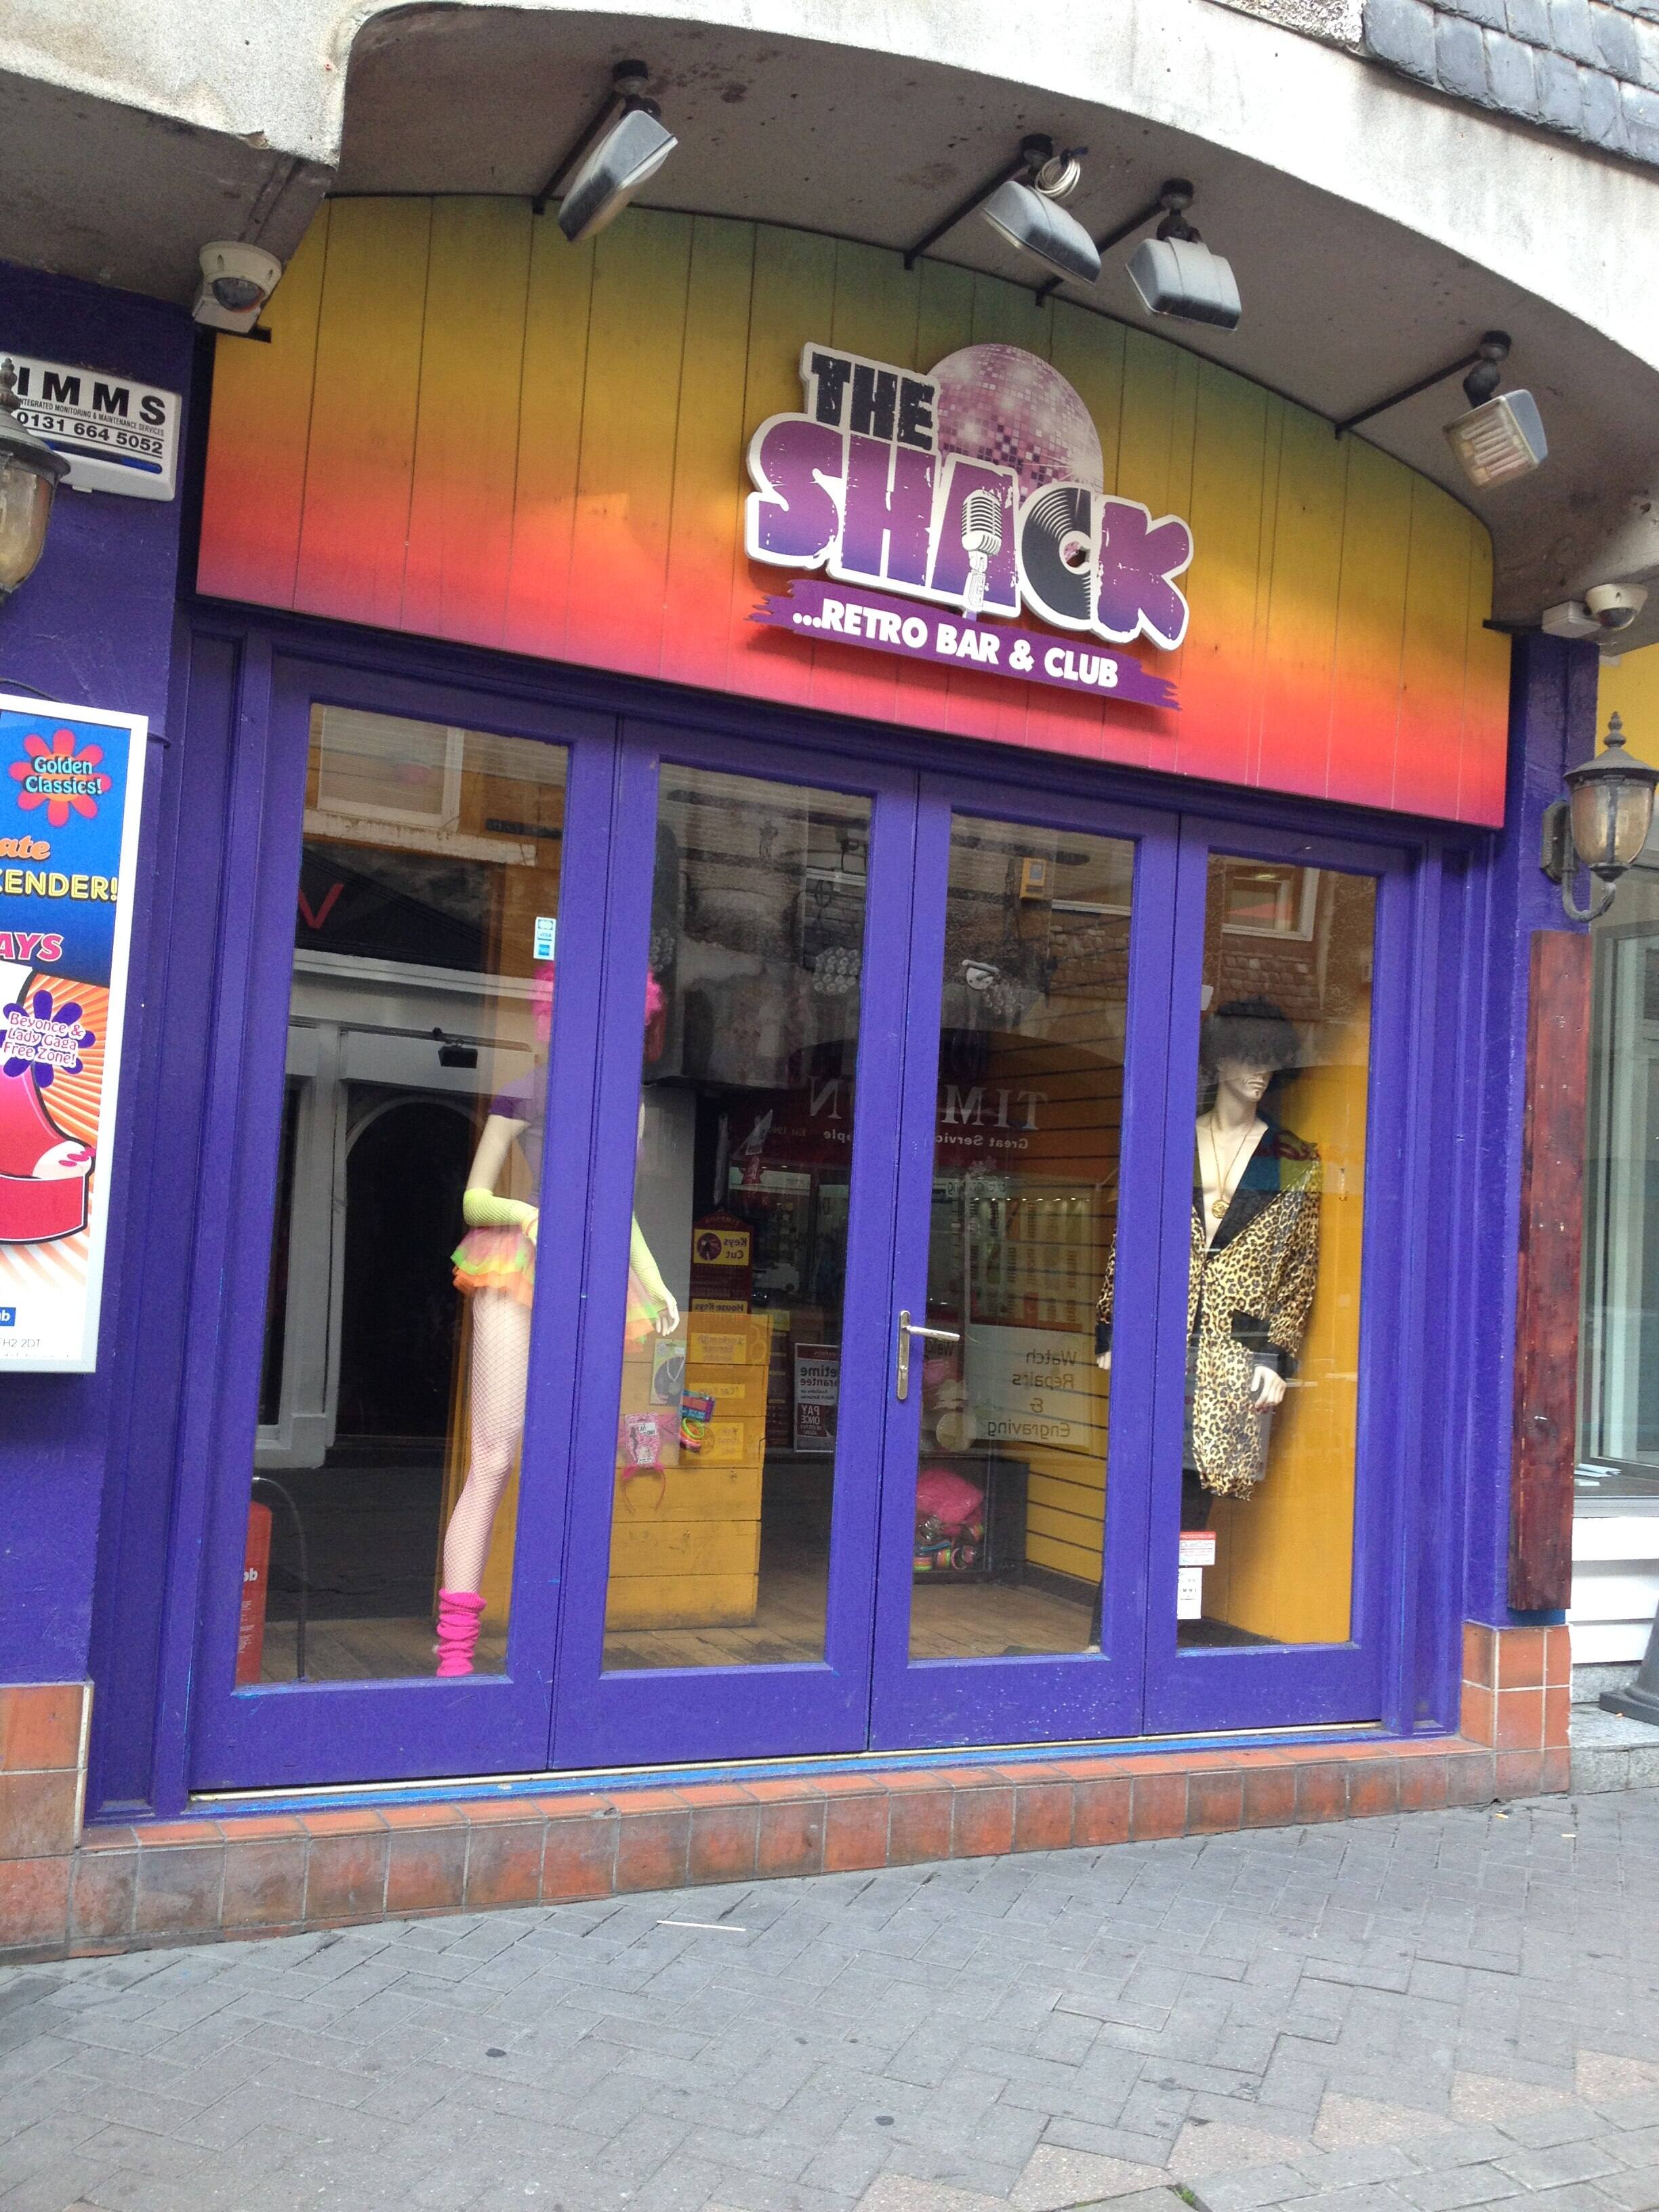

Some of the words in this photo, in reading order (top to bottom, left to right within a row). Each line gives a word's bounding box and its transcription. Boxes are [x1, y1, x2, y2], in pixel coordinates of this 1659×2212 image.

[17, 367, 166, 426] IMMS
[810, 349, 936, 451] THE
[17, 411, 65, 432] 0131
[74, 422, 110, 441] 664
[116, 432, 163, 455] 5052
[19, 397, 54, 411] NTEGRATED
[55, 405, 92, 419] MONITORING
[98, 413, 138, 430] MAINTENANCE
[138, 424, 165, 437] SERVICES
[751, 416, 1192, 645] SHACK
[936, 625, 1000, 665] BAR
[1008, 639, 1033, 672] &
[1044, 647, 1119, 688] CLUB
[34, 756, 93, 775] Golden
[25, 776, 102, 794] Classics!
[0, 869, 118, 901] ENDER!
[7, 1027, 40, 1043] Lady
[43, 1034, 77, 1050] Gaga
[9, 1012, 66, 1034] Beyonce
[70, 1024, 83, 1037] &
[3, 1042, 34, 1058] Free
[37, 1047, 76, 1065] Zone!
[0, 1338, 17, 1348] H2
[21, 1338, 41, 1348] 2DT
